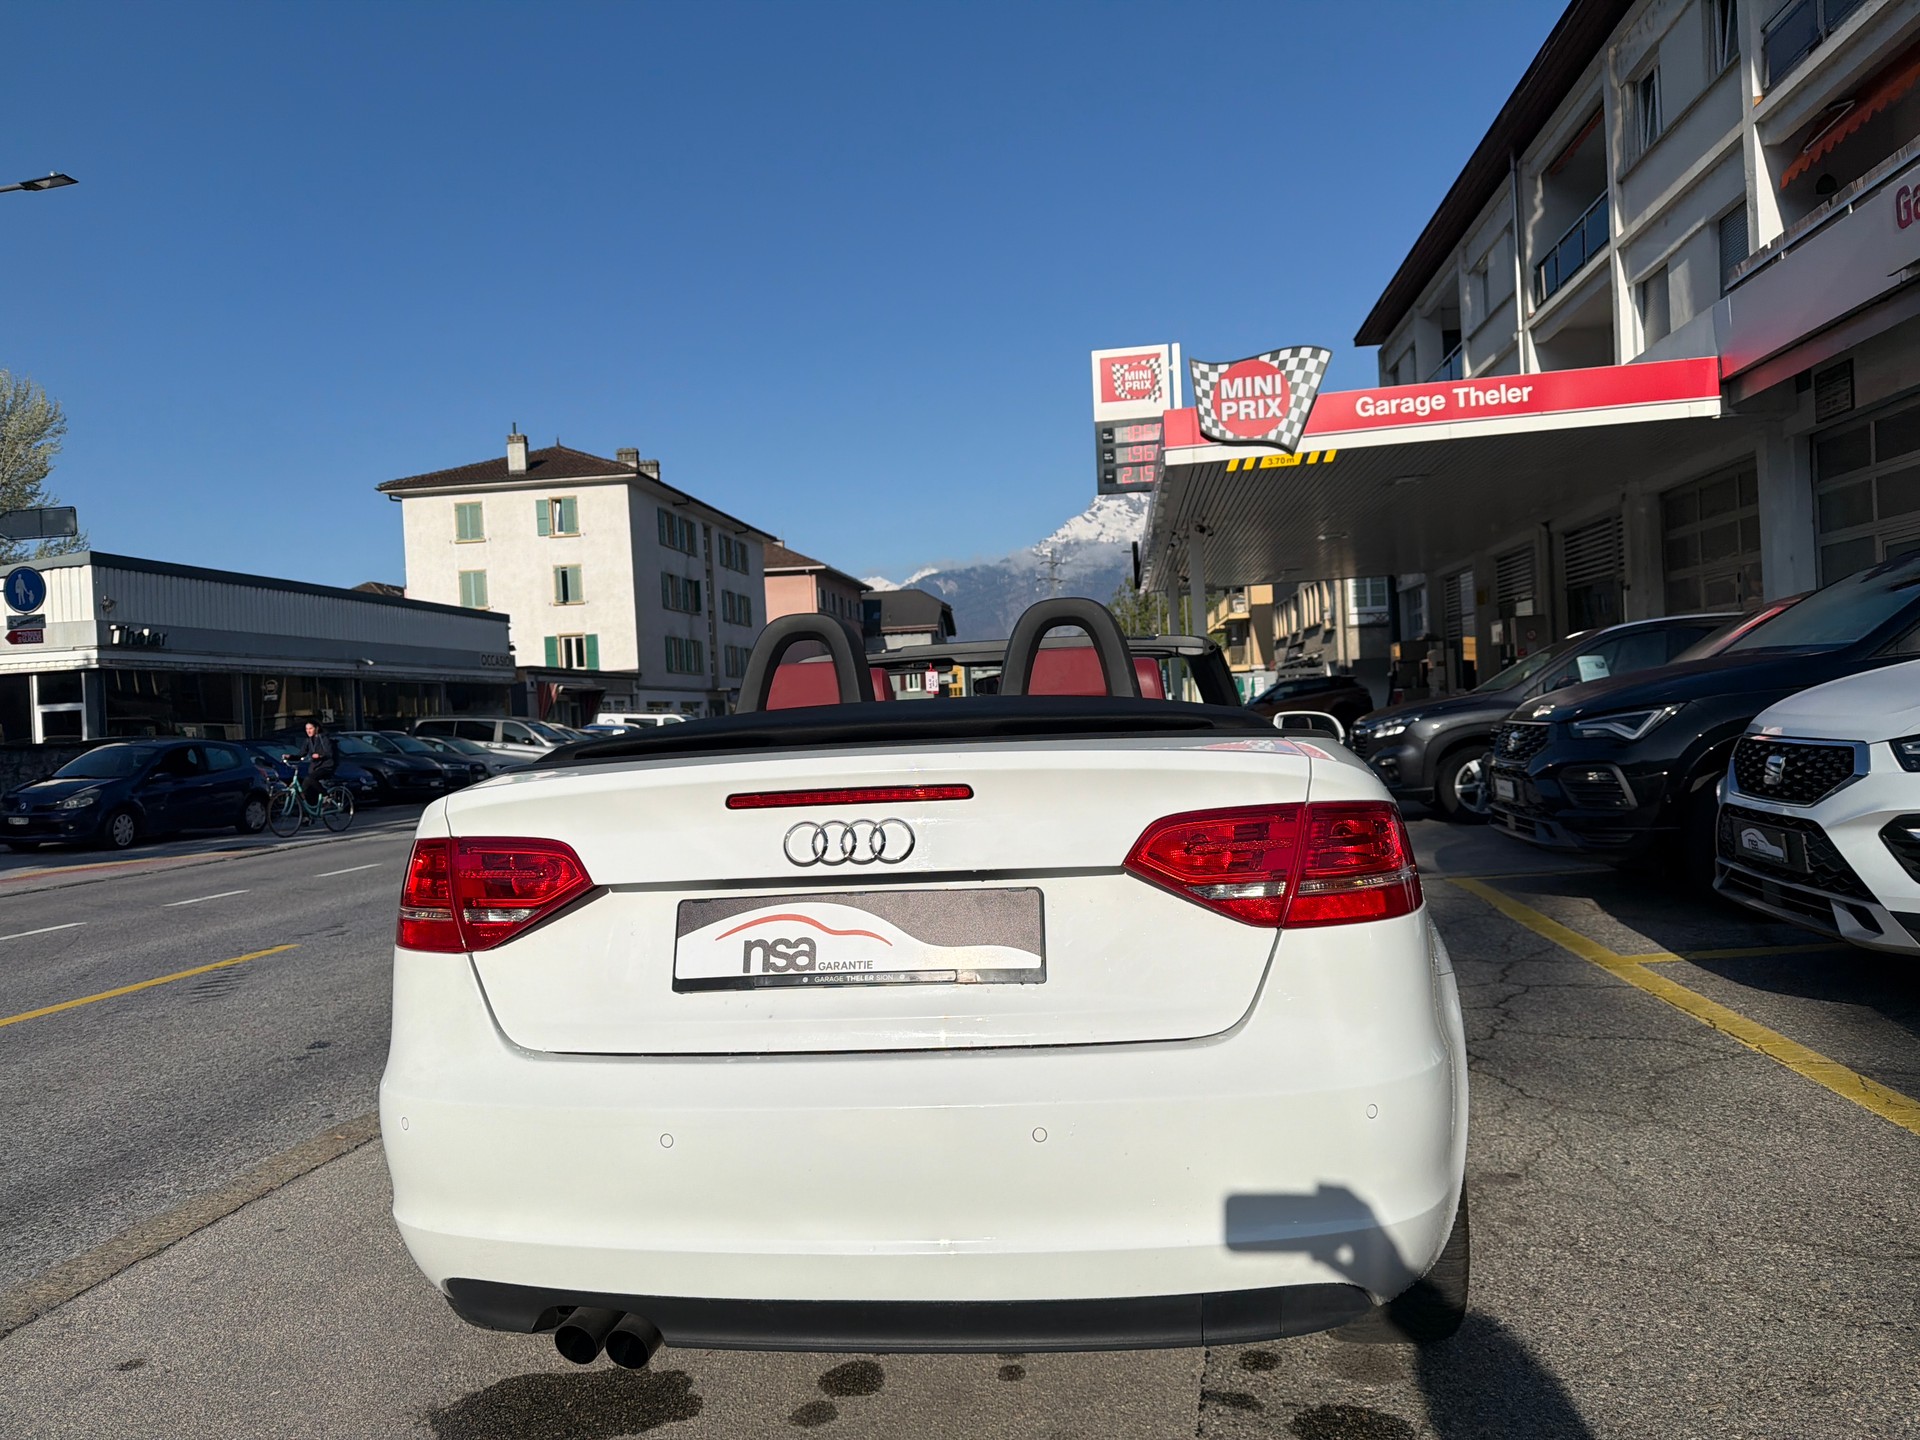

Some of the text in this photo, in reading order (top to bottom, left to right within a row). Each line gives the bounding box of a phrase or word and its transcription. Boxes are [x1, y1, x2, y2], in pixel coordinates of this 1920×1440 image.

[1124, 369, 1152, 381] MINI
[1124, 379, 1152, 391] PRIX
[1220, 373, 1282, 400] MINI
[1355, 383, 1533, 417] Garage Theler
[1221, 397, 1283, 422] PRIX
[1267, 457, 1285, 465] 3.70
[742, 937, 816, 974] nsa
[818, 960, 873, 971] GARANTIE
[846, 974, 874, 982] THELER
